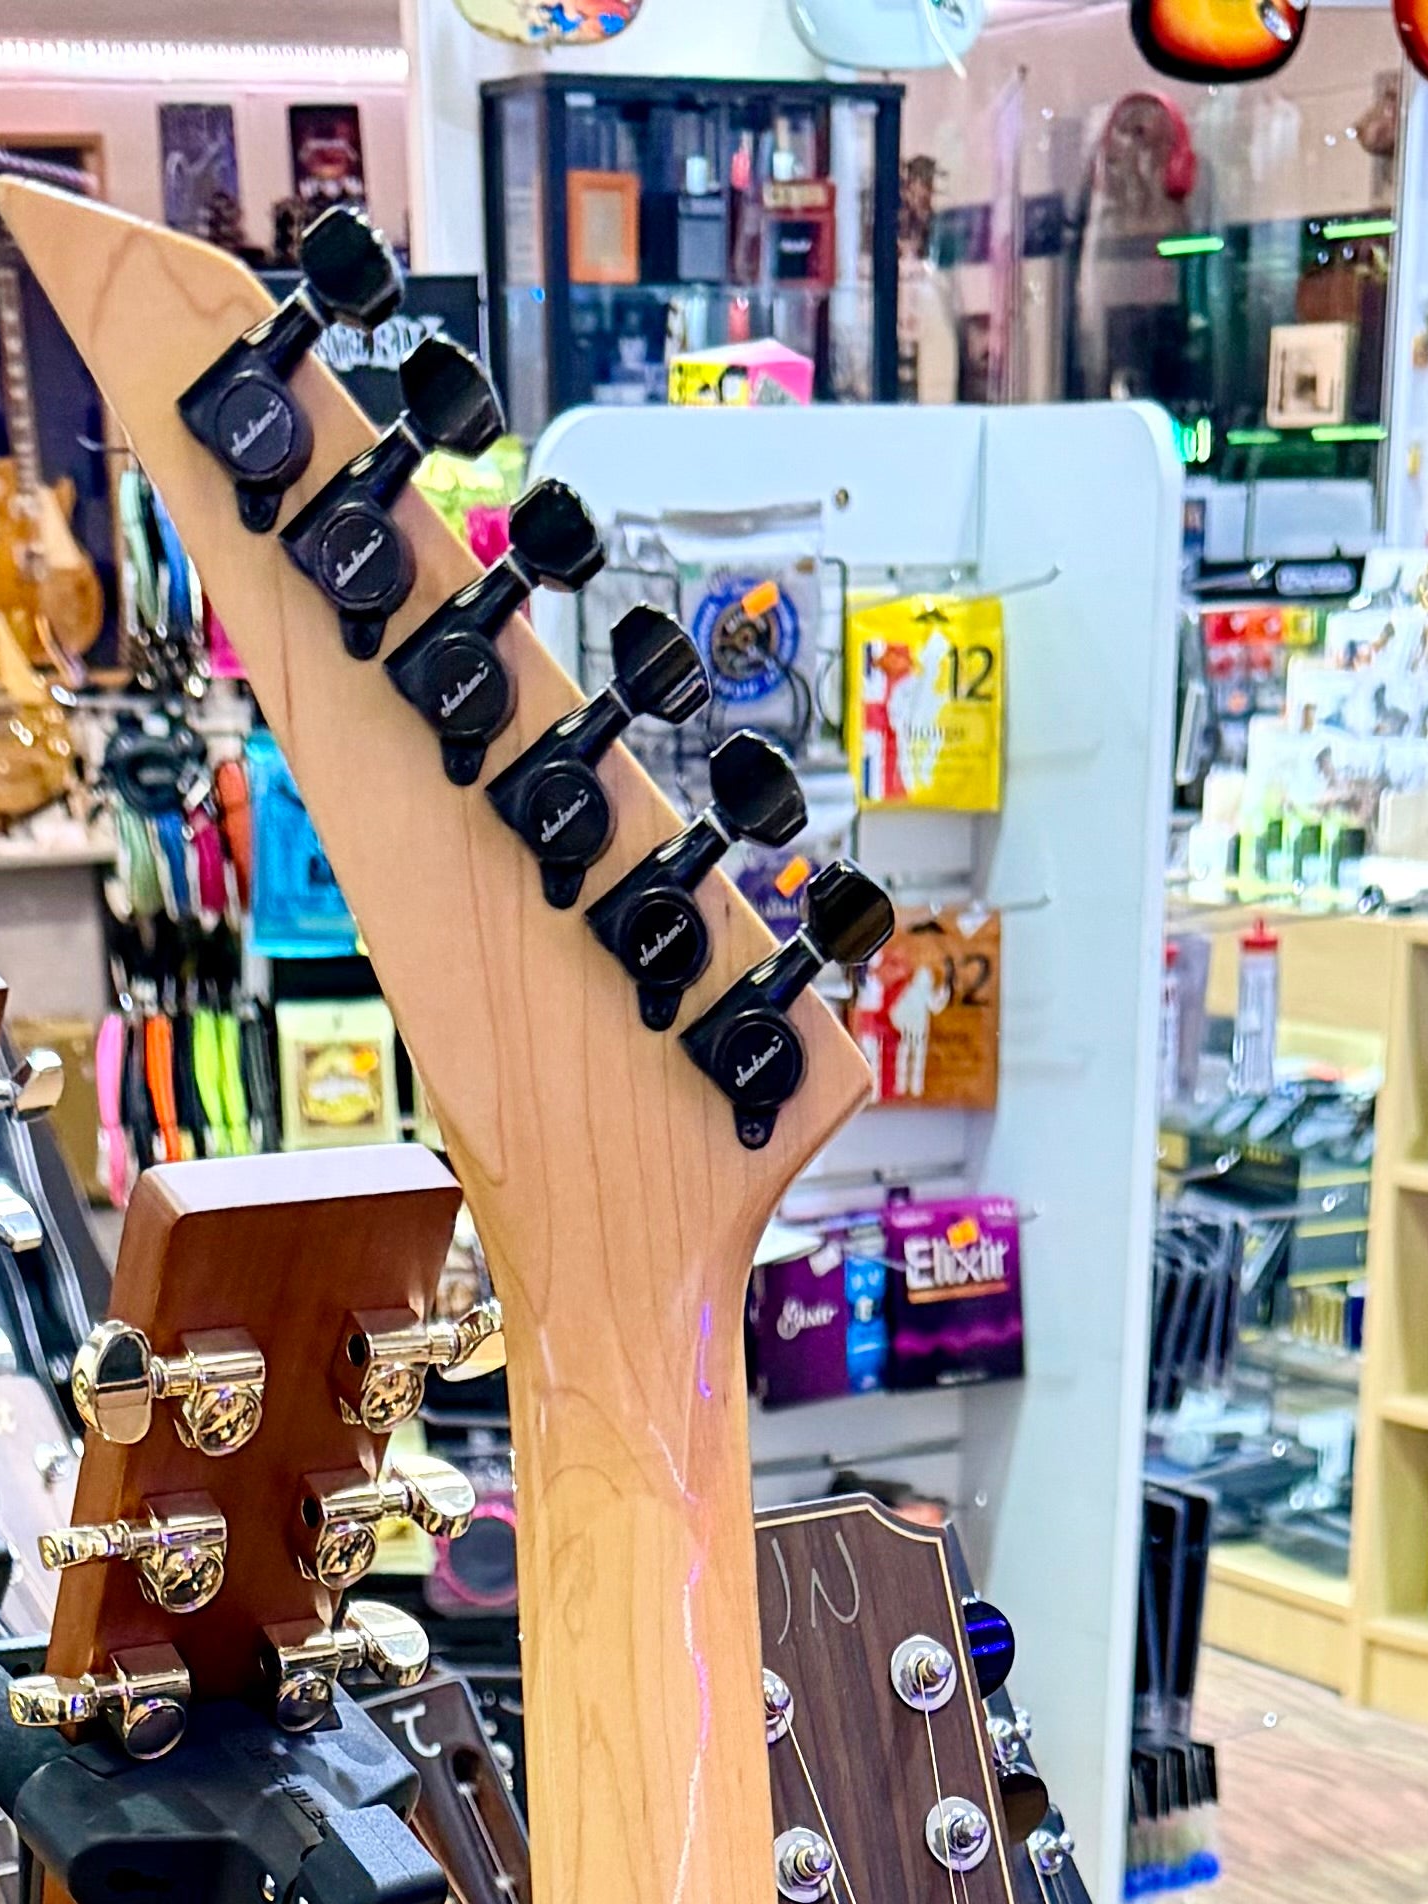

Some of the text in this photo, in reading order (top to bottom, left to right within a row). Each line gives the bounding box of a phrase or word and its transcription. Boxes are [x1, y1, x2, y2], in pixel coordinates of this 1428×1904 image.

[231, 400, 282, 457] Jackson
[335, 528, 384, 588] Jackson
[440, 661, 489, 718] Jackson
[948, 646, 993, 702] 12
[540, 789, 589, 843] Jackson
[639, 914, 688, 967] Jackson
[734, 1035, 784, 1088] Jackson
[905, 1238, 1007, 1289] Elixir
